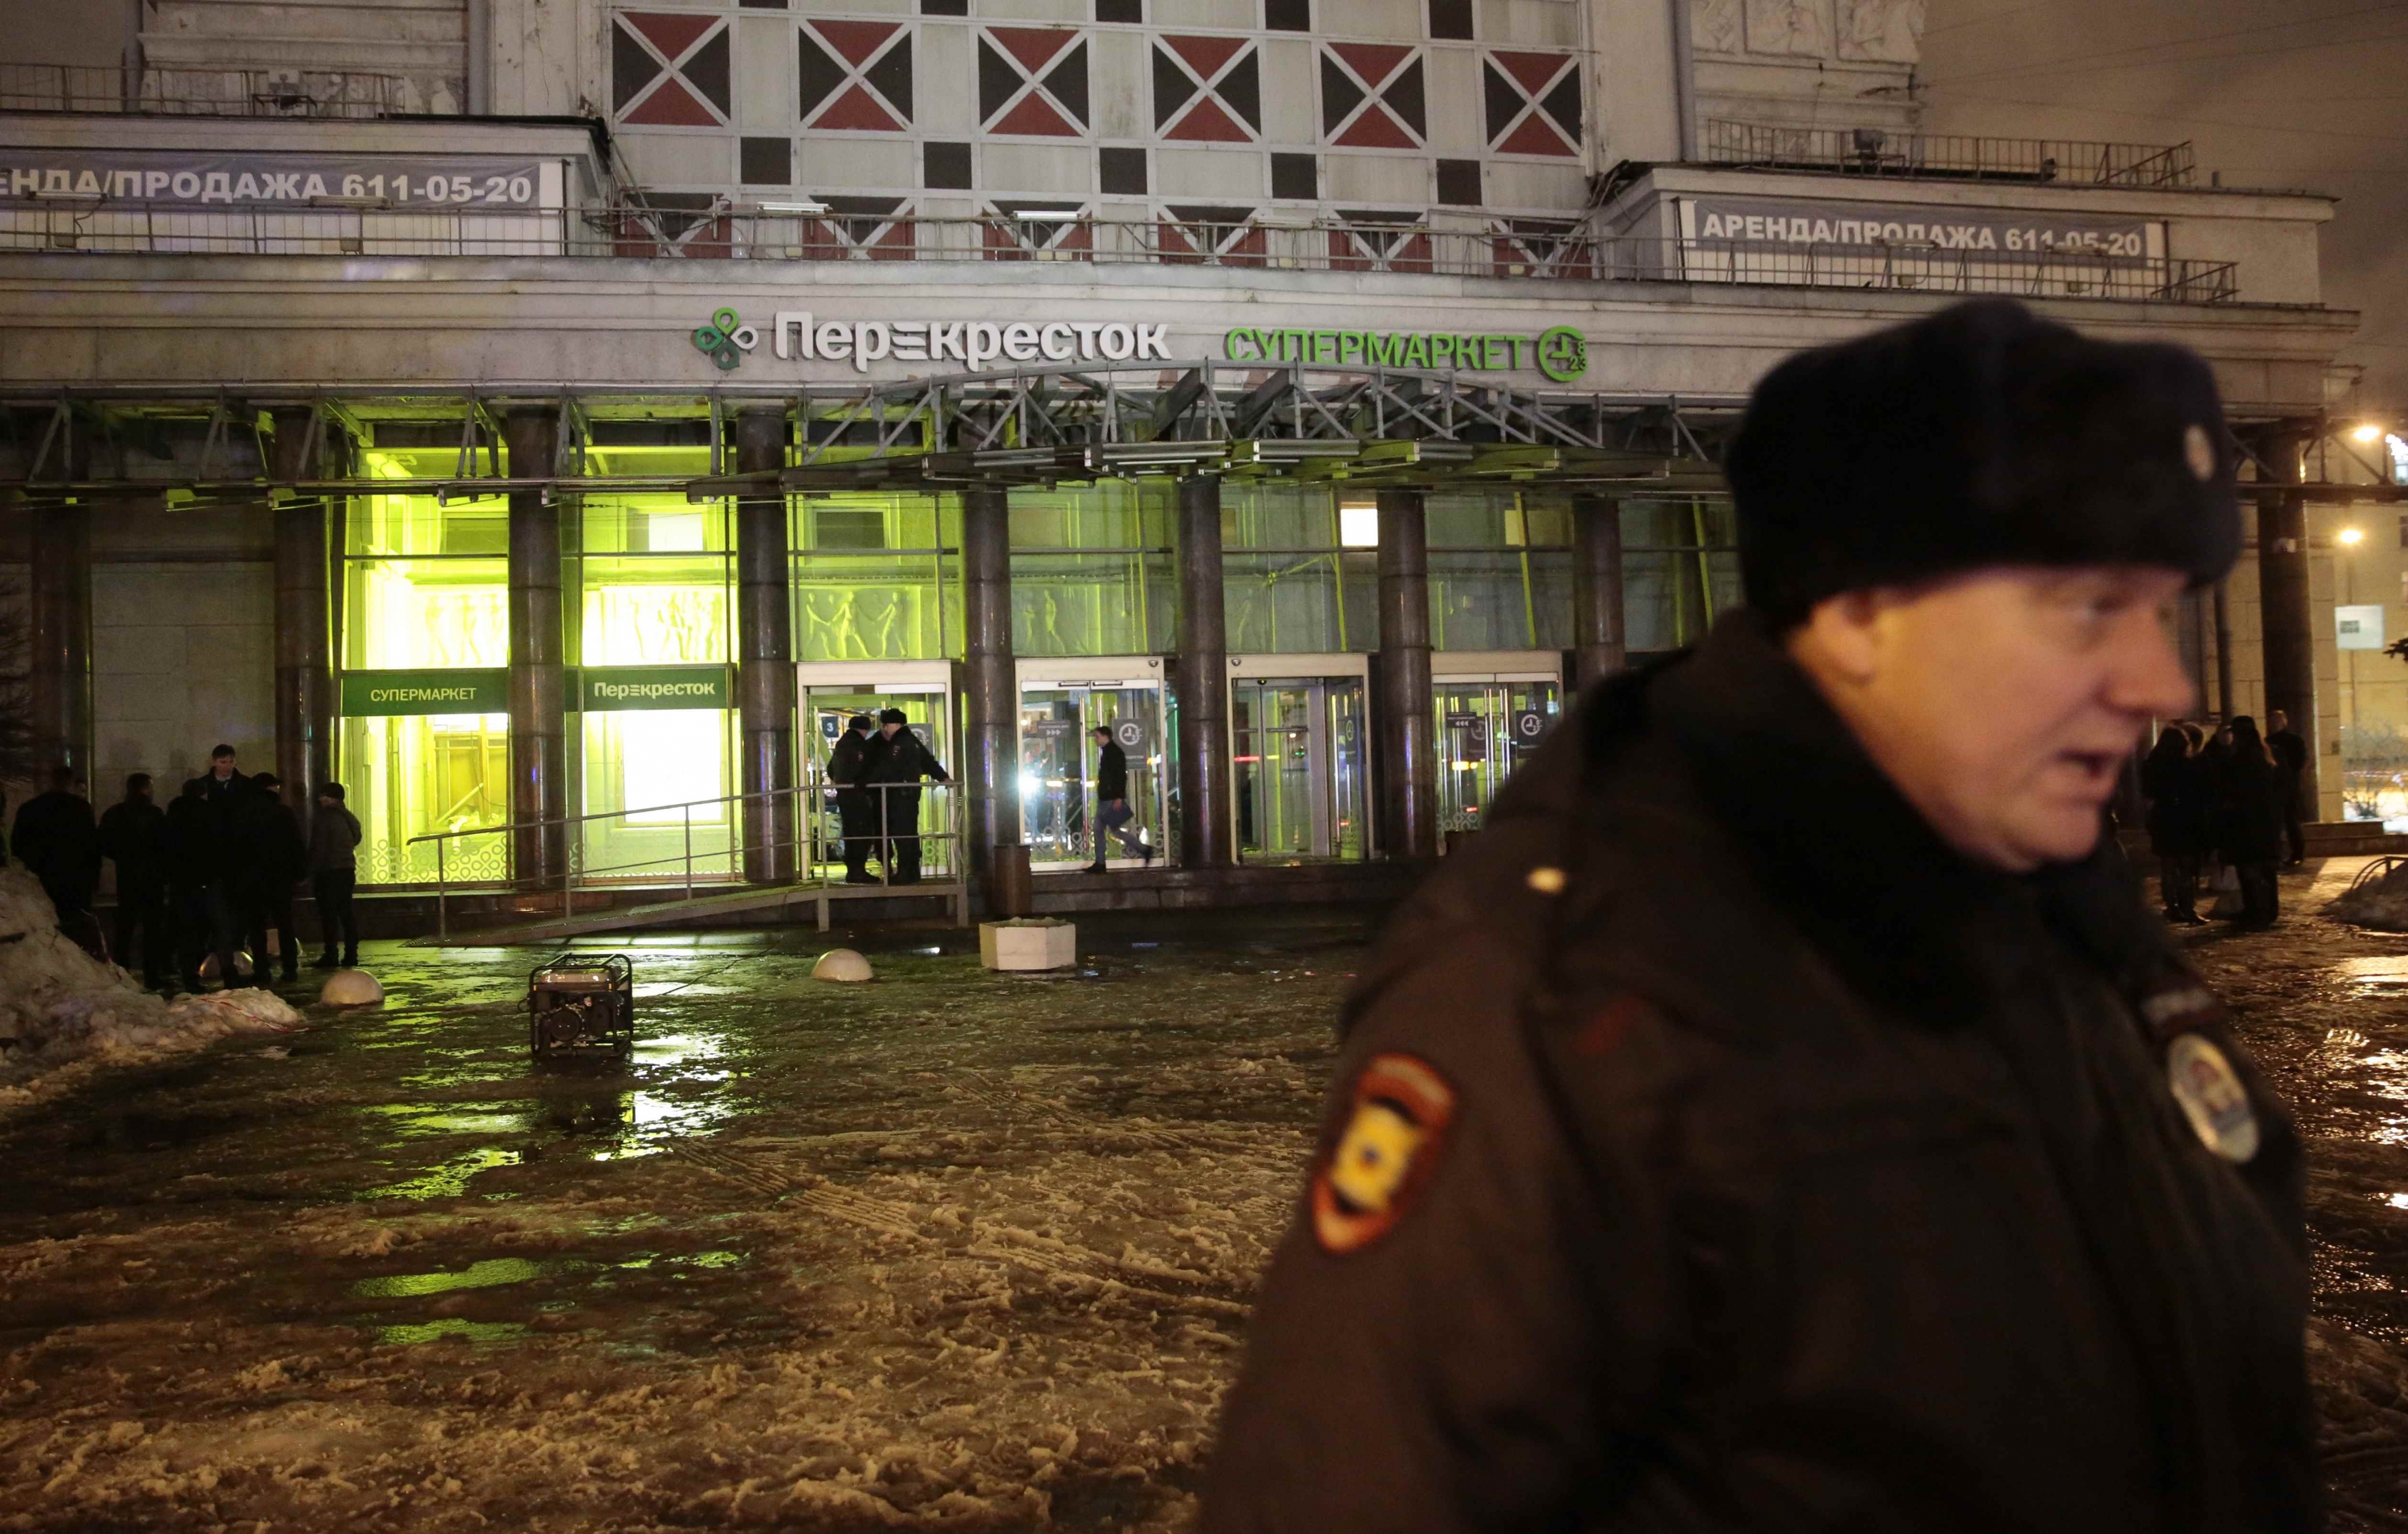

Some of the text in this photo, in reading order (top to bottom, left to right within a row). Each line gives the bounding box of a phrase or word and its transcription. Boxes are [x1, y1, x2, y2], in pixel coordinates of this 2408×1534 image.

[342, 174, 531, 202] 611-05-20
[1702, 213, 2142, 256] АРЕНДА/ПРОДАЖА 611-05-20
[775, 311, 1172, 373] Перекресток
[1226, 327, 1527, 370] СУПЕРМАРКЕТ
[370, 687, 477, 702] СУПЕРМАРКЕТ
[594, 682, 716, 701] Перекресток
[827, 722, 834, 731] 3
